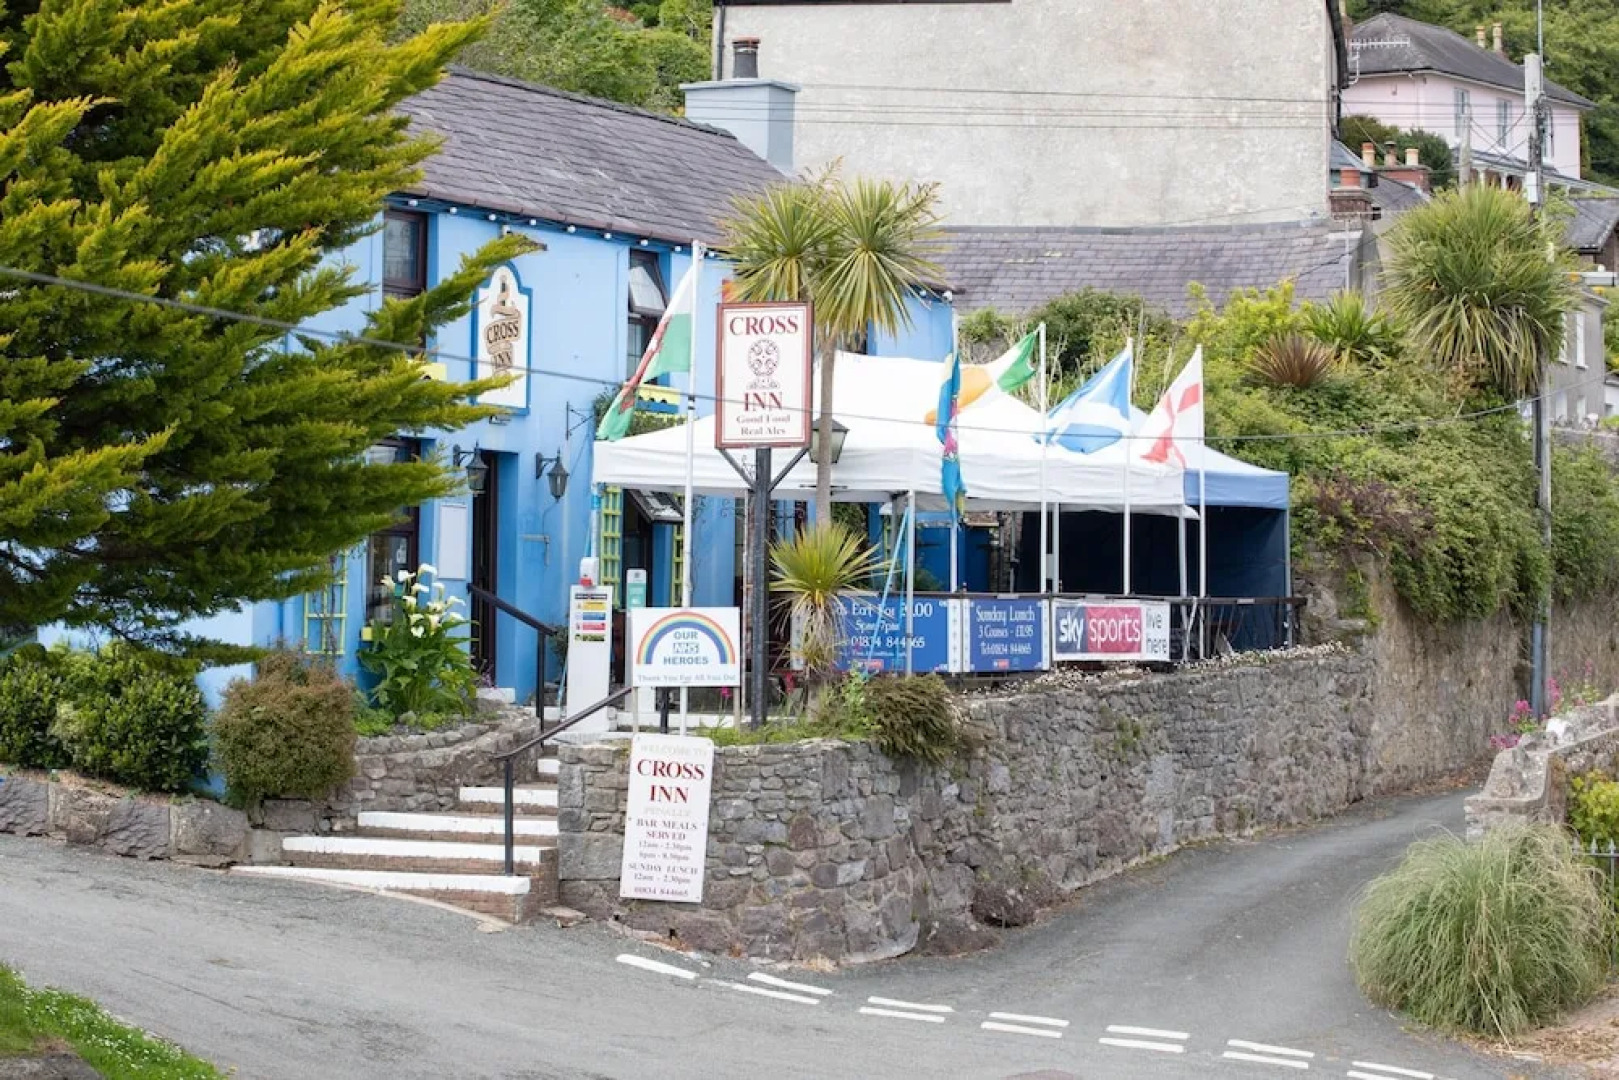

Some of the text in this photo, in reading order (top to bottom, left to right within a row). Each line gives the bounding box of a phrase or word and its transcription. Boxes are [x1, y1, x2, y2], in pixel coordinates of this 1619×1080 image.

[486, 320, 519, 344] CROSS
[729, 315, 799, 336] CROSS
[493, 350, 512, 369] INN
[744, 392, 783, 412] INN
[736, 414, 763, 424] Good
[740, 427, 786, 436] Real Ales
[975, 605, 1036, 626] Sunday Lunch
[673, 631, 698, 640] OUR
[1059, 612, 1141, 650] sky sports
[1146, 634, 1167, 654] here
[663, 656, 709, 665] HEROES
[637, 758, 705, 780] CROSS
[649, 784, 689, 804] INN
[636, 818, 698, 830] BAR MEALS
[646, 830, 686, 840] SERVED
